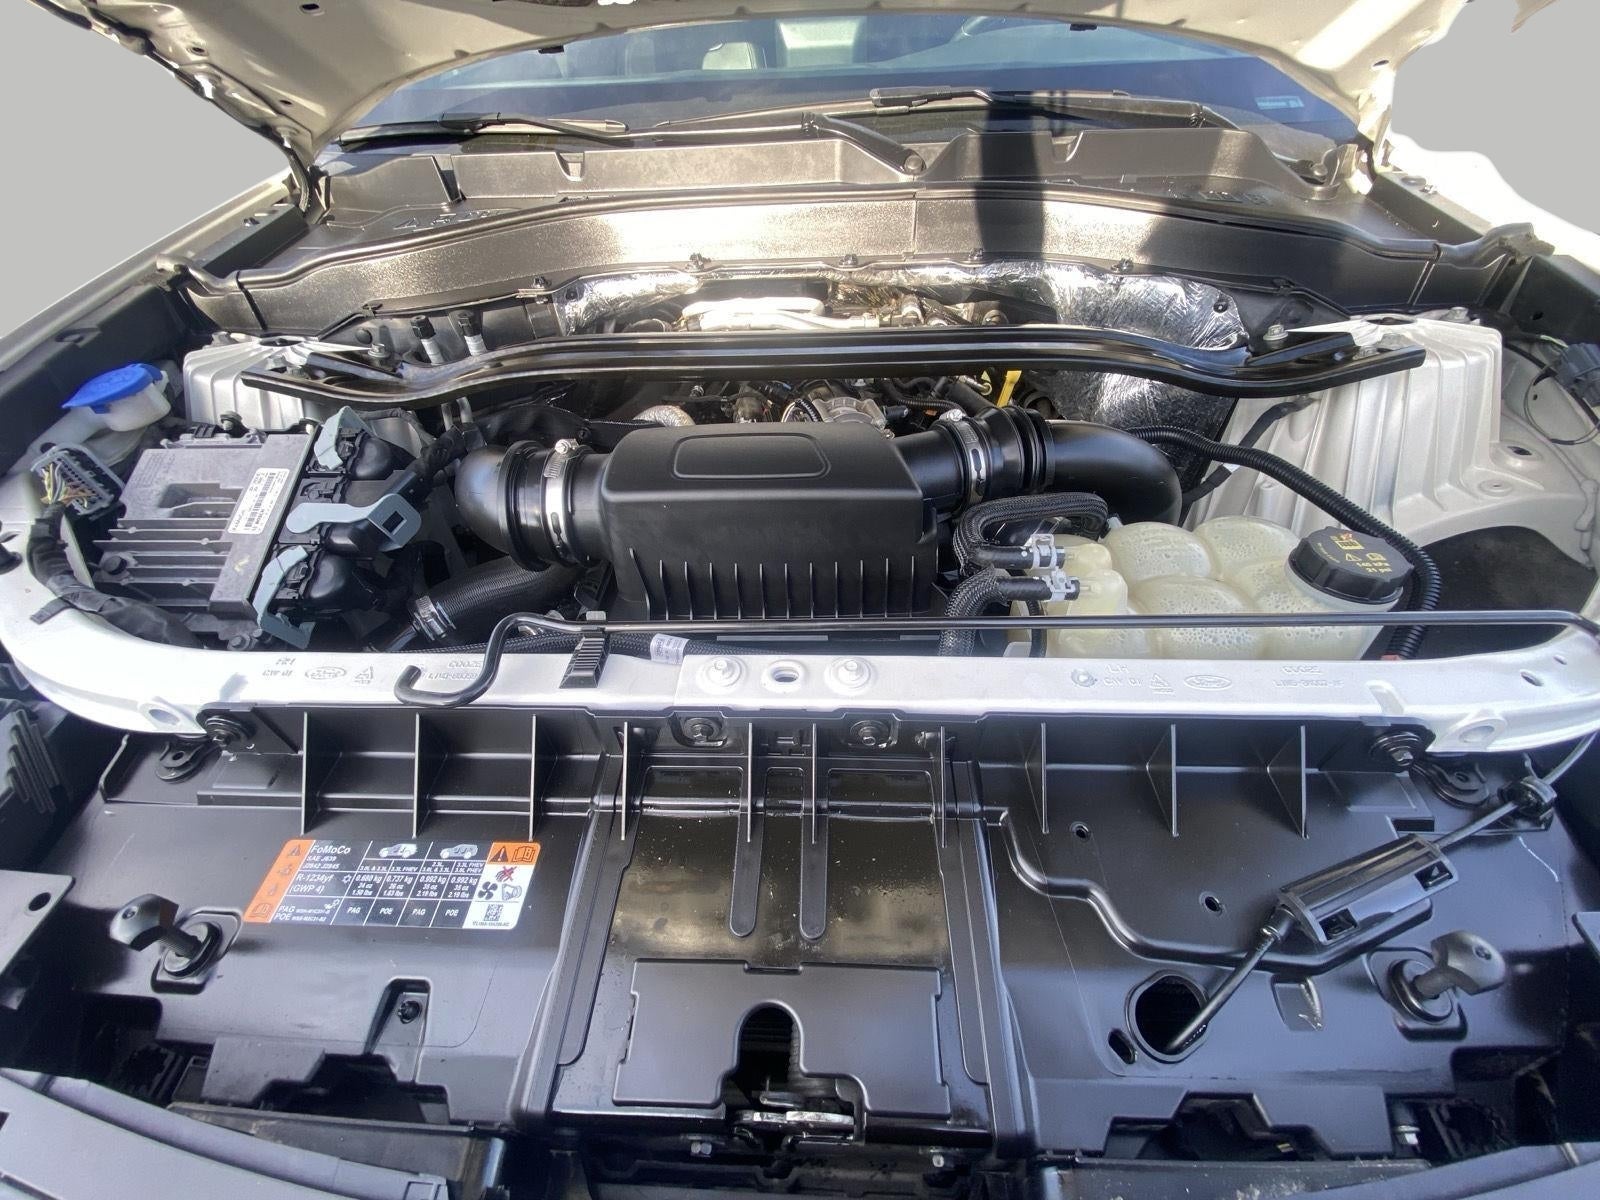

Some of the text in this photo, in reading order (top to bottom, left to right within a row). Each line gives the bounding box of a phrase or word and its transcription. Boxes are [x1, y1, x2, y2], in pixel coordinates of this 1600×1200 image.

[311, 845, 351, 855] FoMoCo
[296, 874, 334, 883] R-1234yf
[373, 875, 383, 883] kg
[404, 876, 413, 884] kg
[420, 875, 447, 885] 0.992 kg
[450, 876, 478, 886] 0.992 kg
[289, 884, 313, 893] (GWP
[278, 905, 295, 914] PAG
[379, 907, 393, 915] POE
[445, 909, 459, 917] POE
[273, 913, 291, 921] POE
